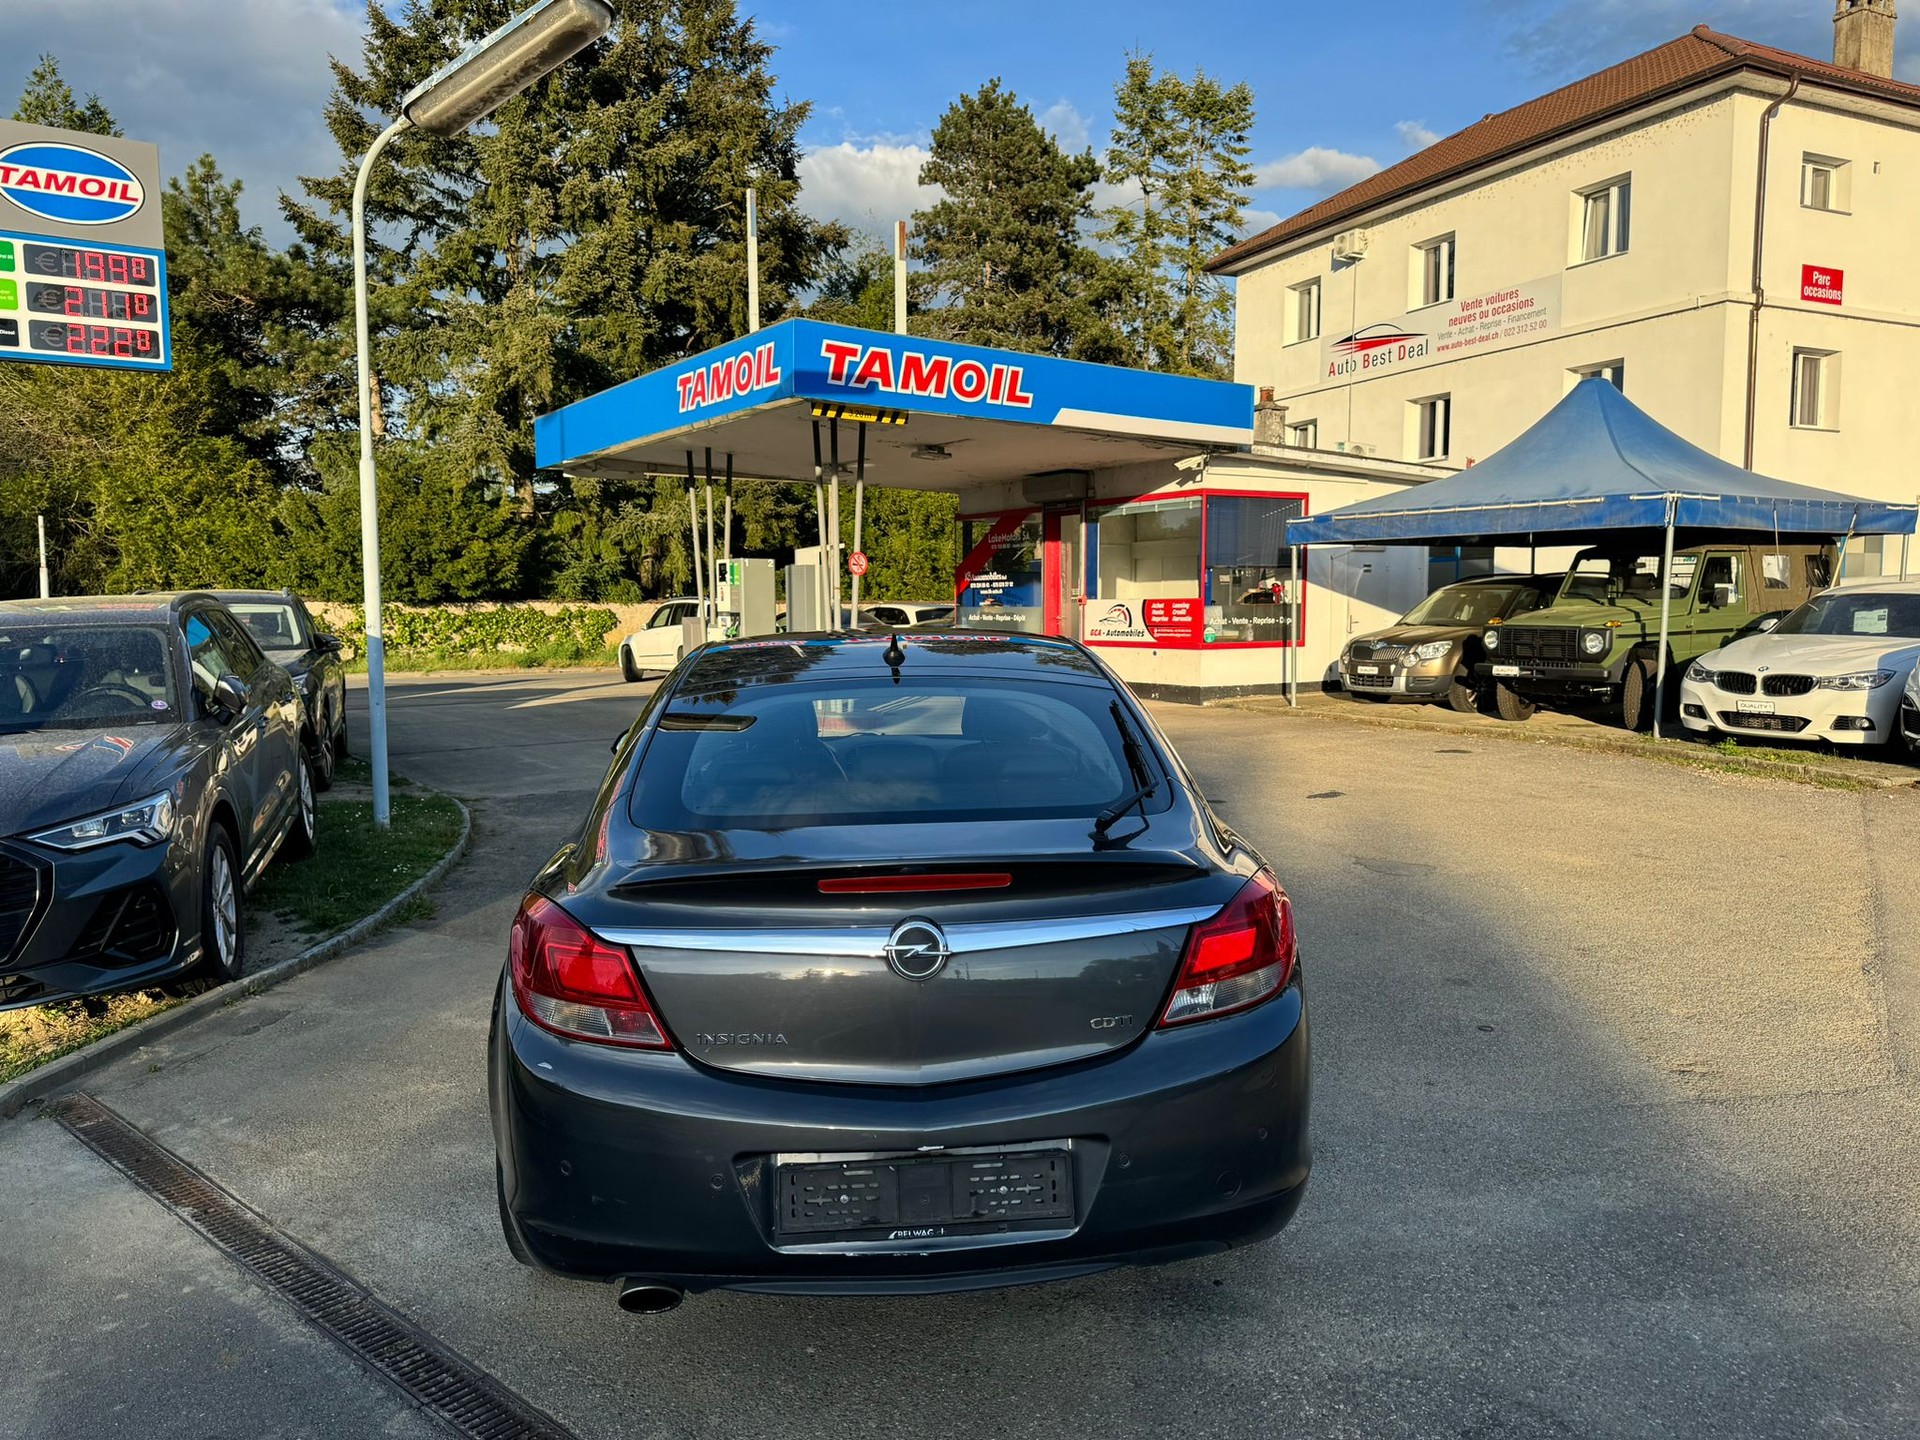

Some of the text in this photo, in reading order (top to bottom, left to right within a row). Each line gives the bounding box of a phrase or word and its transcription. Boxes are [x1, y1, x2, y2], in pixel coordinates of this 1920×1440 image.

[0, 166, 138, 202] TAMOIL
[1812, 271, 1830, 285] Parc
[1460, 289, 1519, 312] Vente voitures
[1804, 286, 1841, 300] occasions
[1448, 298, 1534, 327] neuves ou occasions
[1458, 325, 1474, 336] Achat
[1480, 319, 1501, 331] Reprise
[1507, 307, 1547, 324] Financement
[1504, 327, 1516, 337] 022
[1516, 325, 1528, 335] 312
[1530, 322, 1538, 331] 52
[1539, 319, 1547, 329] 00
[1328, 339, 1428, 377] Auto Best Deal
[678, 342, 780, 412] TAMOIL
[824, 340, 1033, 407] TAMOIL
[1253, 617, 1275, 626] Reprise
[1106, 629, 1144, 637] Automobiles
[1090, 1014, 1132, 1029] CDTI
[696, 1033, 788, 1045] INSIGNIA
